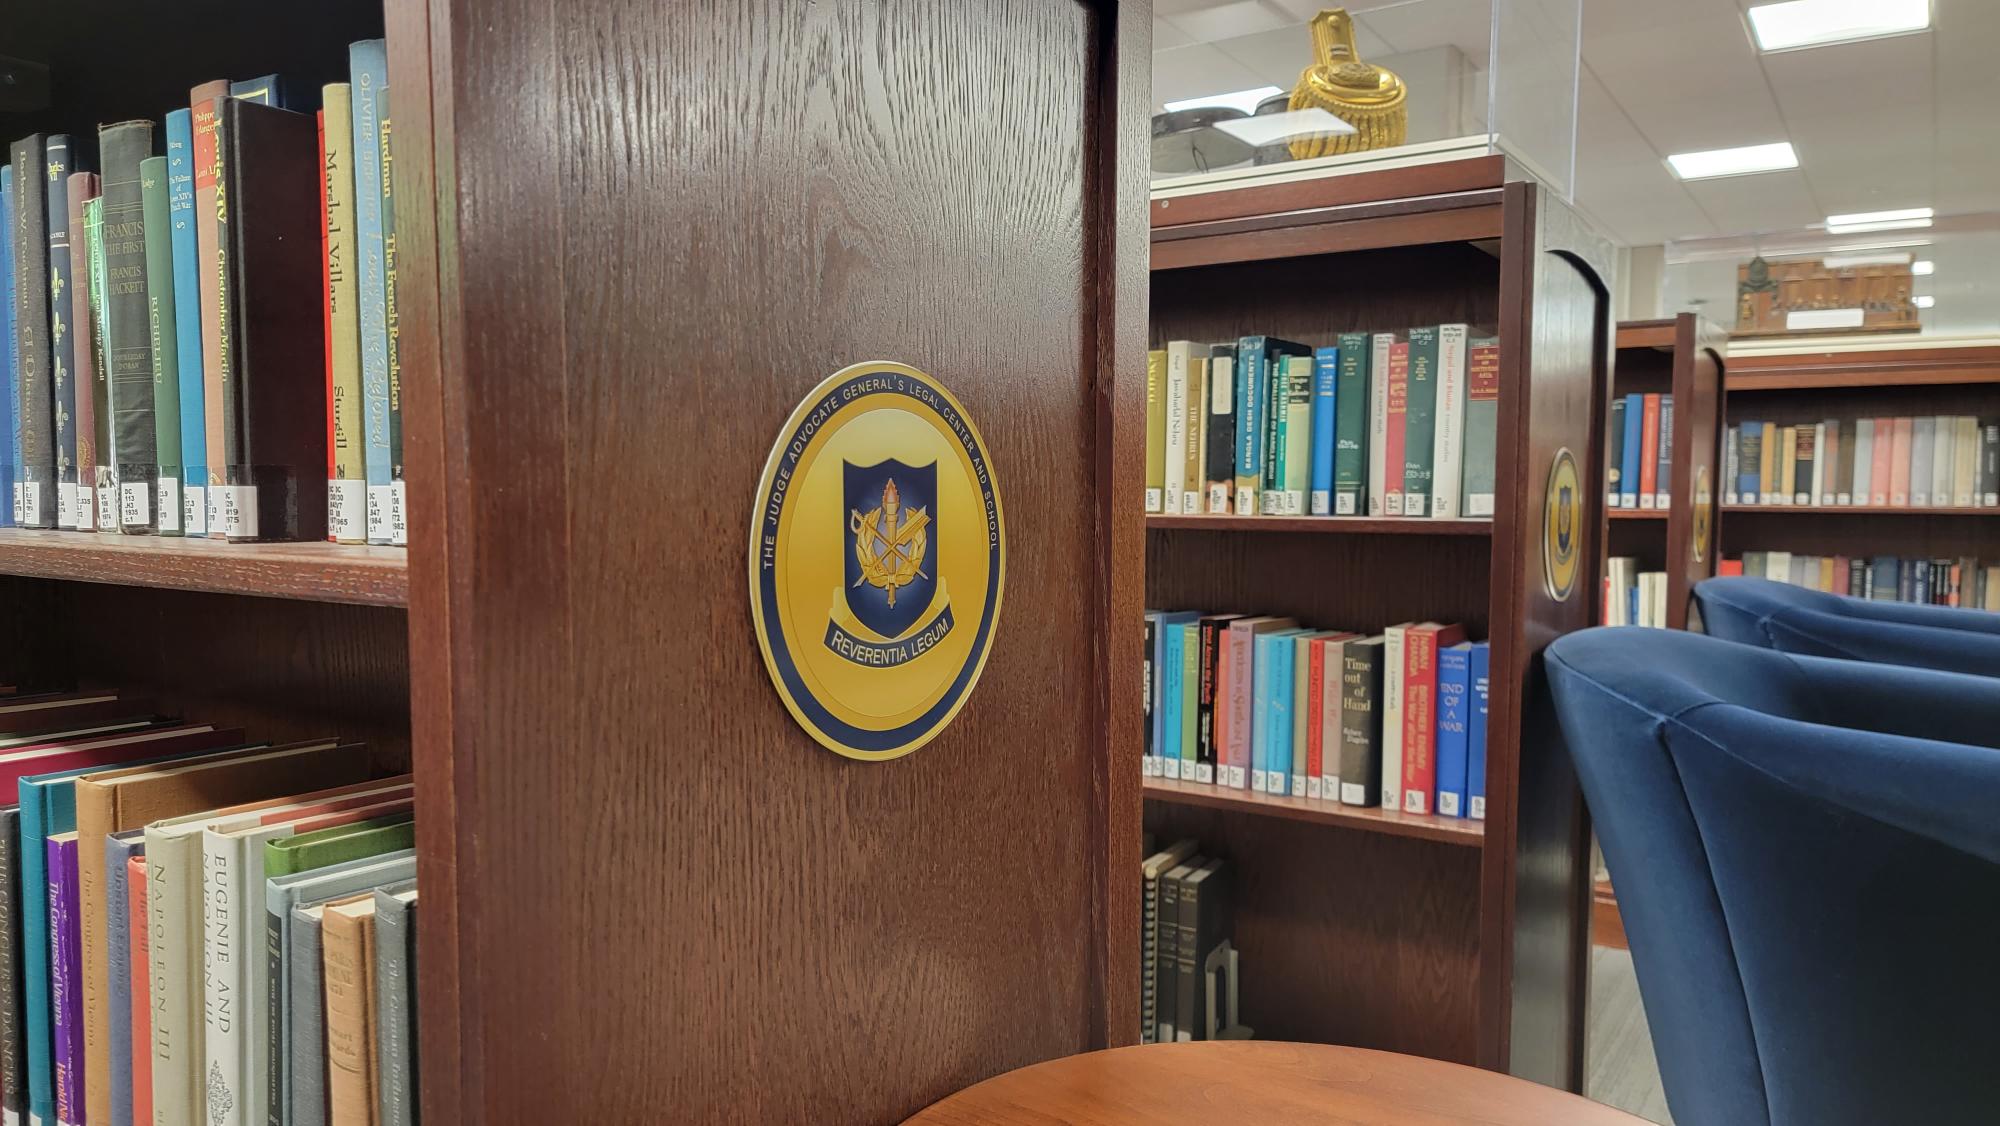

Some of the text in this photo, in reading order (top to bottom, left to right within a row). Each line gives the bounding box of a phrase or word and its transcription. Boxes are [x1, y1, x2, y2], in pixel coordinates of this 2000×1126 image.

[360, 73, 372, 143] OLIVIER
[216, 181, 227, 224] XIV
[20, 213, 27, 233] W.
[104, 221, 143, 238] FRANCIS
[122, 240, 145, 254] FIRST
[381, 117, 400, 411] Hardman The French Revolution
[21, 236, 29, 308] Tuchman
[109, 280, 145, 295] HACKETT
[110, 266, 142, 279] FRANCIS
[218, 249, 228, 332] Christopher
[326, 150, 348, 449] Marshal Villars Sturgill
[152, 297, 163, 384] RICHELIEU
[220, 335, 230, 382] Martin
[1247, 355, 1255, 407] DOCUMENTS
[1246, 407, 1254, 433] DESH
[1244, 435, 1253, 469] BANGLA
[763, 375, 998, 569] THE JUDGE ADVOCATE GENERAL'S LEGAL CENTER AND SCHOOL
[831, 618, 949, 664] REVERENTIA LEGUM
[1344, 673, 1361, 683] out
[1345, 657, 1372, 672] Time
[1344, 697, 1372, 711] Hand
[1354, 686, 1367, 697] of
[1408, 685, 1417, 701] The
[1440, 682, 1464, 694] END
[1444, 695, 1459, 707] OF
[1408, 702, 1416, 721] War
[1440, 721, 1464, 733] WAR
[1447, 710, 1456, 720] A
[1407, 764, 1415, 783] War
[49, 881, 60, 906] The
[1, 891, 13, 1005] CONGRESS
[51, 907, 62, 967] Congress
[214, 854, 231, 1034] EUGENIE AND
[53, 968, 62, 982] of
[83, 870, 97, 1048] The Congress of Vienna
[154, 864, 170, 1061] NAPOLEON III
[387, 958, 400, 990] The
[53, 983, 64, 1026] Vienna
[390, 995, 400, 1056] German
[4, 1013, 15, 1095] DANCES
[57, 1063, 67, 1098] Harold
